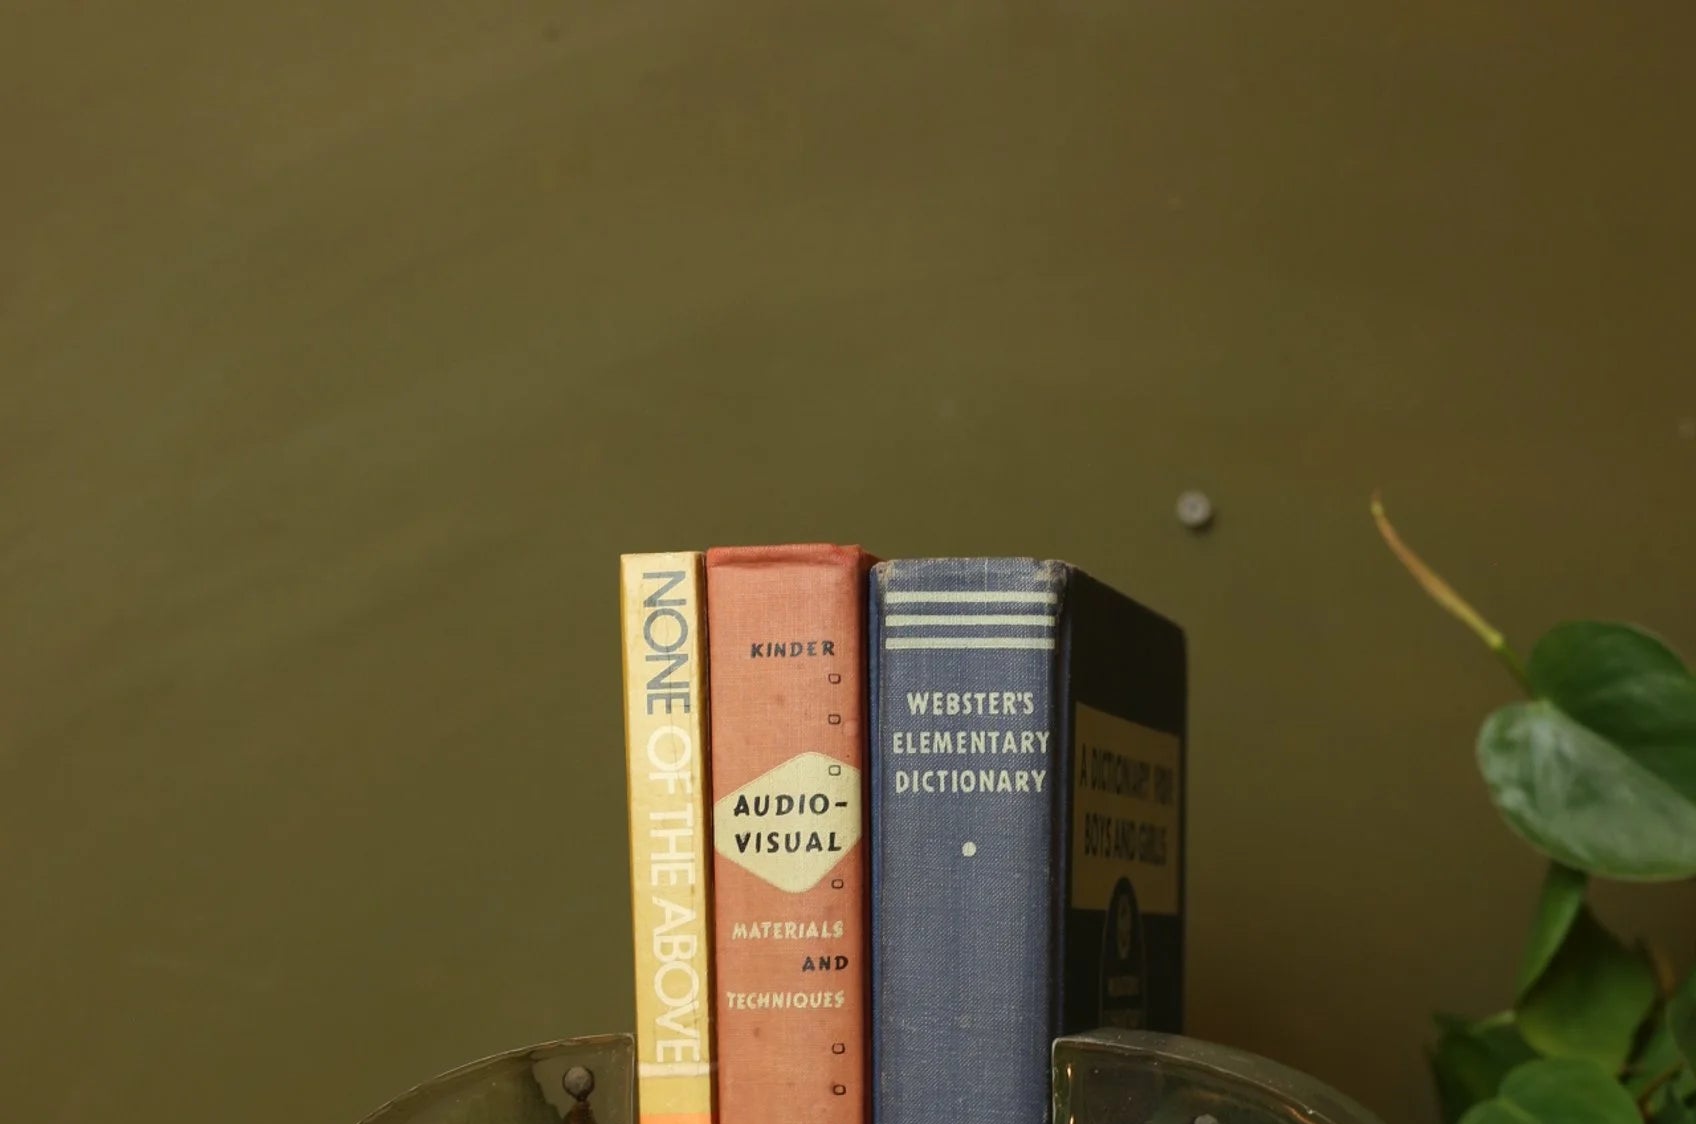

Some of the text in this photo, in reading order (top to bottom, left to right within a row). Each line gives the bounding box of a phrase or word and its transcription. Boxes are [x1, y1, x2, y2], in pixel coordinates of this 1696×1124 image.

[749, 639, 836, 659] KINDER
[906, 691, 1035, 716] WEBSTER'S
[892, 730, 1051, 755] ELEMENTARY
[895, 769, 1048, 794] DICTIONARY
[643, 570, 700, 1063] NONE OF THE ABOVE
[733, 792, 849, 818] AUDIO-
[734, 831, 843, 854] VISUAL
[1084, 812, 1113, 858] BOYS
[1114, 817, 1136, 863] AND
[731, 920, 844, 941] MATERIALS
[801, 955, 849, 972] AND
[726, 990, 846, 1010] TECHNIQUES
